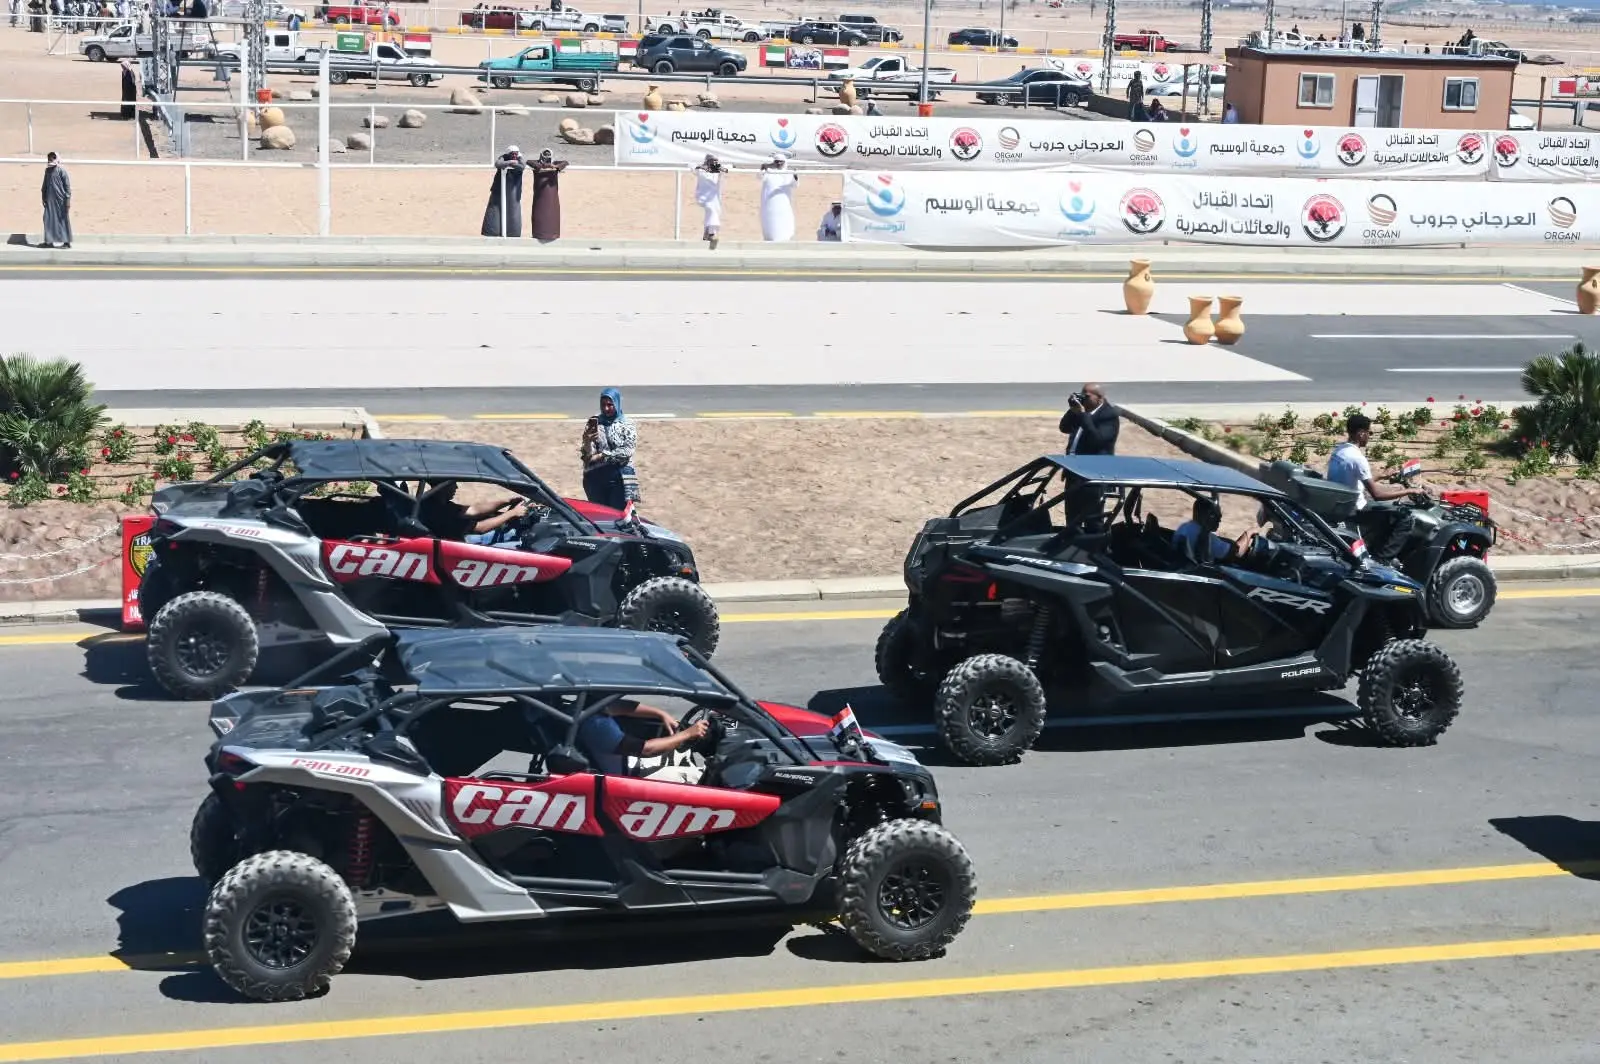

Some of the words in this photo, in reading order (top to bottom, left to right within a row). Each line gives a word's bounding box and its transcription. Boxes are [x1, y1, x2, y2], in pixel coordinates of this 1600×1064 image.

[672, 129, 714, 143] الوسيم
[717, 128, 757, 144] جمعية
[870, 125, 902, 139] القبائل
[905, 126, 929, 140] إتحاد
[1029, 140, 1065, 153] جروب
[1068, 140, 1124, 155] العرجاني
[1386, 133, 1415, 147] القبائل
[1539, 136, 1568, 150] القبائل
[856, 142, 895, 157] المصرية
[898, 144, 942, 158] والعائلات
[1210, 141, 1248, 155] الوسيم
[1250, 140, 1285, 156] جمعية
[1374, 151, 1409, 165] المصرية
[1527, 154, 1560, 167] المصرية
[1561, 156, 1599, 168] والعائلات
[925, 195, 983, 214] الوسيم
[987, 192, 1040, 217] جمعية
[1193, 190, 1237, 210] القبائل
[1240, 193, 1273, 213] إتحاد
[1176, 214, 1228, 235] المصرية
[1410, 213, 1458, 229] جروب
[1461, 212, 1536, 233] العرجاني
[1231, 220, 1291, 239] والعائلات
[1362, 229, 1401, 239] ORGANI
[1544, 231, 1581, 241] ORGANI
[329, 544, 428, 580] can
[451, 559, 539, 588] am
[1005, 554, 1053, 566] PRO
[1247, 587, 1332, 614] RZR
[1281, 667, 1321, 678] POLARIS
[291, 758, 370, 777] can-am
[452, 785, 586, 831] can
[619, 801, 736, 838] am
